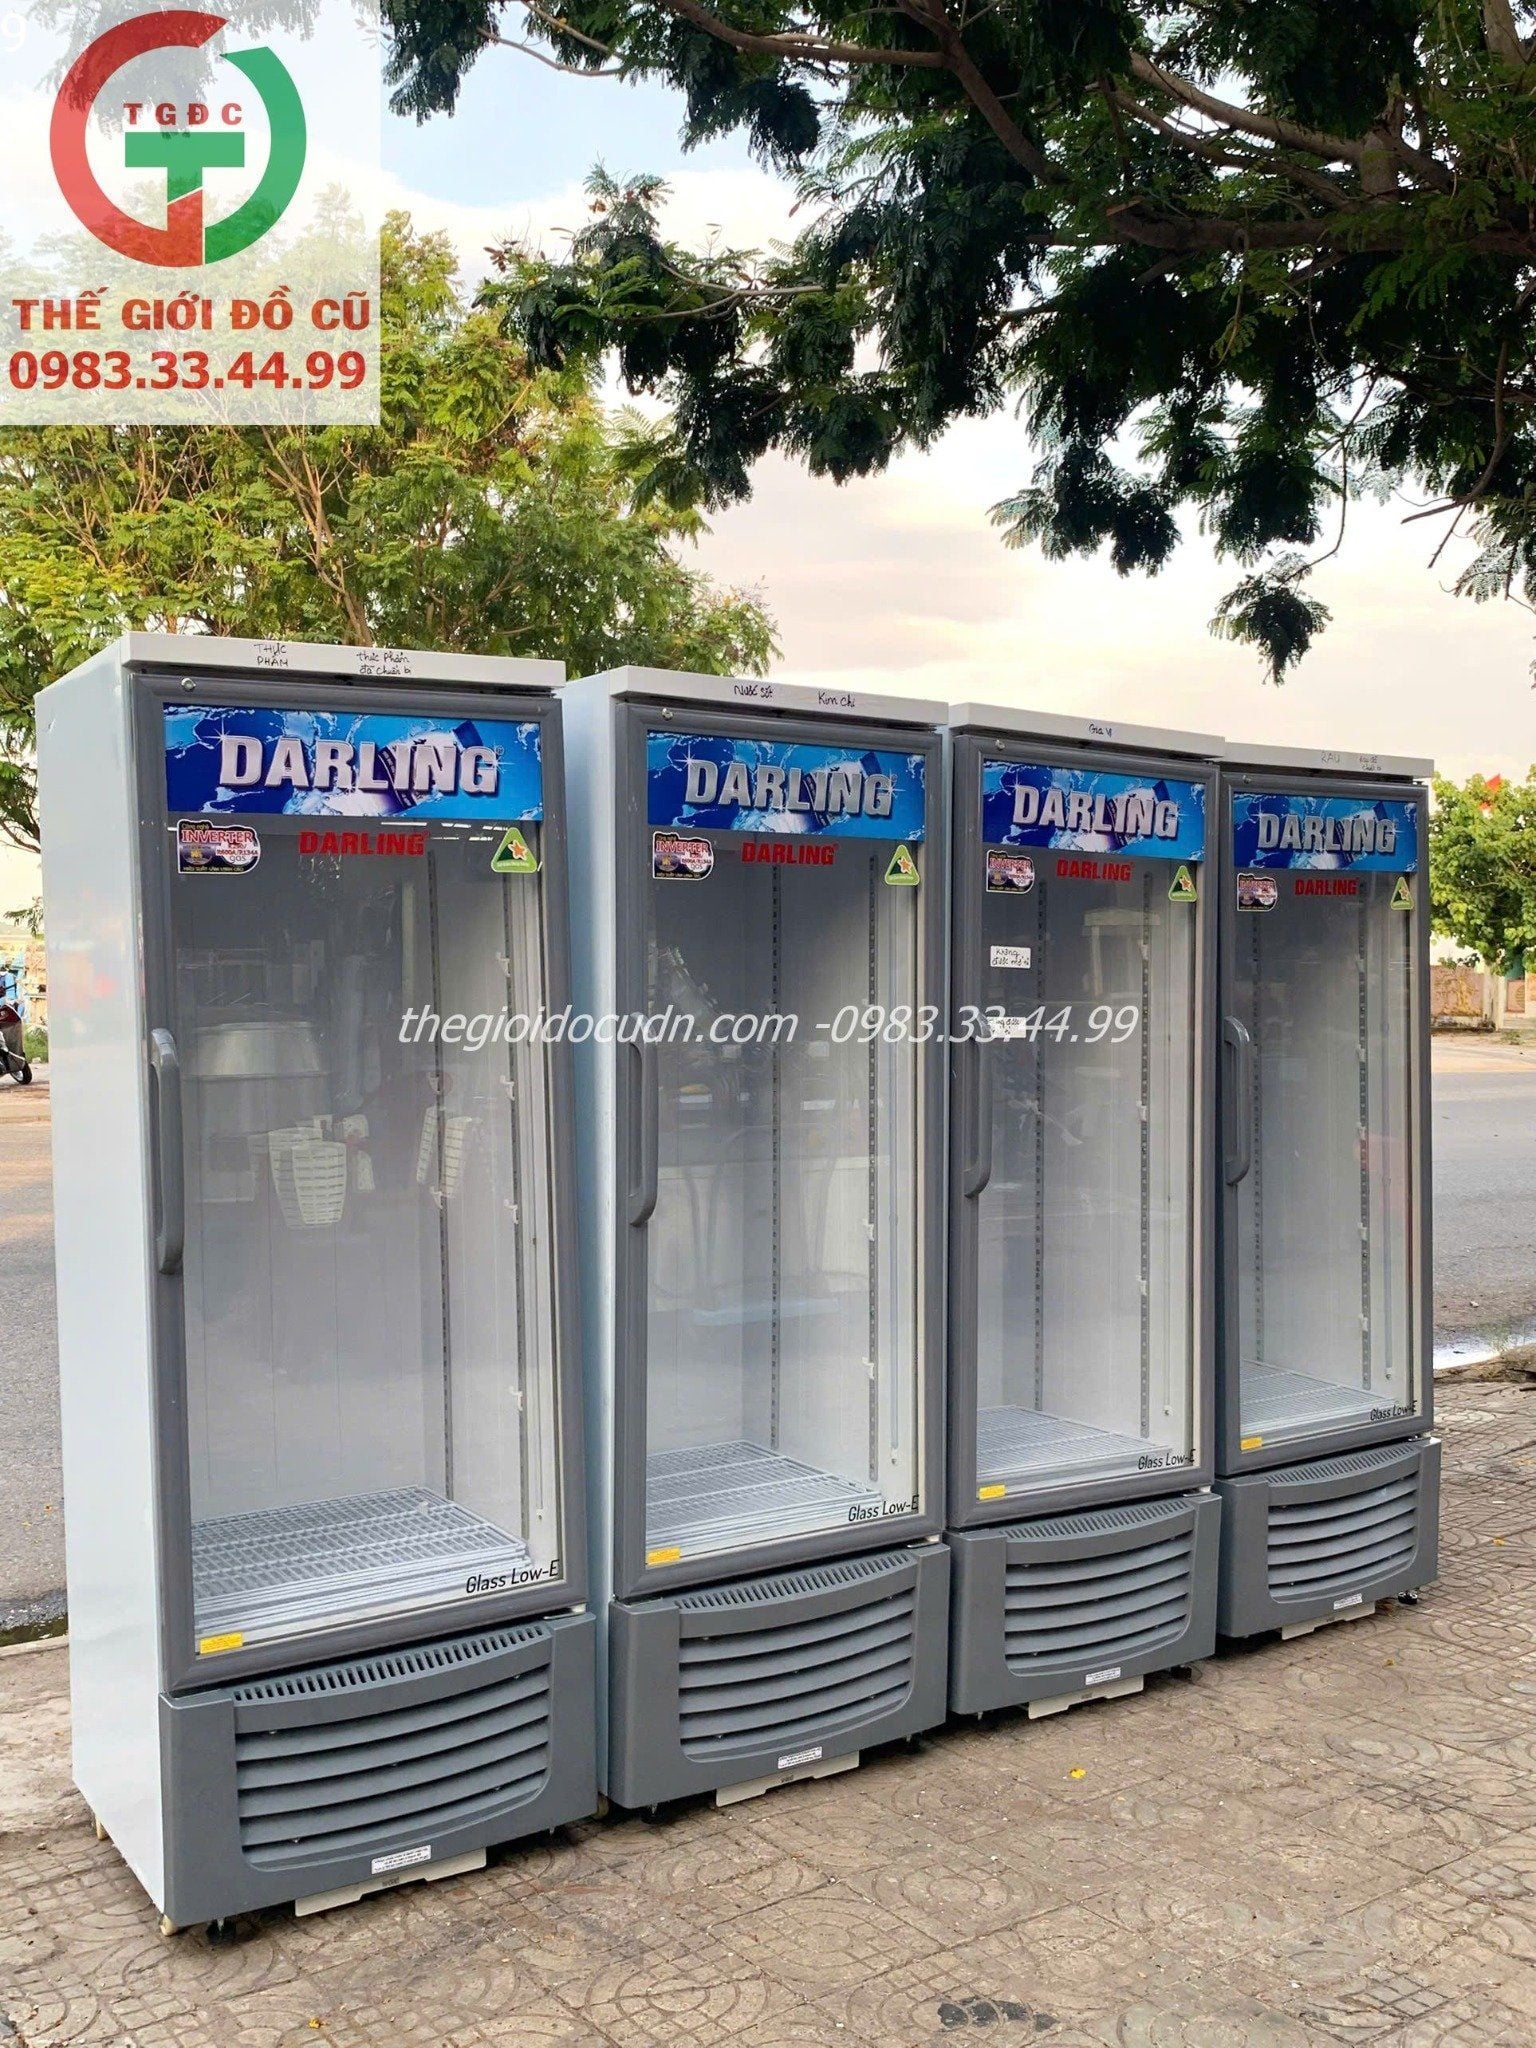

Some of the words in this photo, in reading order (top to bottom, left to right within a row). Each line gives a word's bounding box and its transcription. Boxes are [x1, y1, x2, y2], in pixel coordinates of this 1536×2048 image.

[218, 734, 500, 796] DARLING
[684, 759, 894, 817] DARLING
[1011, 784, 1179, 839] DARLING
[182, 829, 253, 844] INVERTER
[299, 831, 425, 857] DARLING
[1256, 813, 1395, 853] DARLING
[655, 840, 709, 853] INVERTER
[741, 842, 835, 865] DARLING
[1056, 858, 1132, 881] DARLING
[1294, 878, 1358, 896] DARLING
[1138, 1454, 1163, 1470] Glass
[848, 1504, 879, 1522] Glass
[882, 1494, 919, 1516] Low-E
[466, 1574, 507, 1594] Glass
[511, 1559, 560, 1585] Low-E
